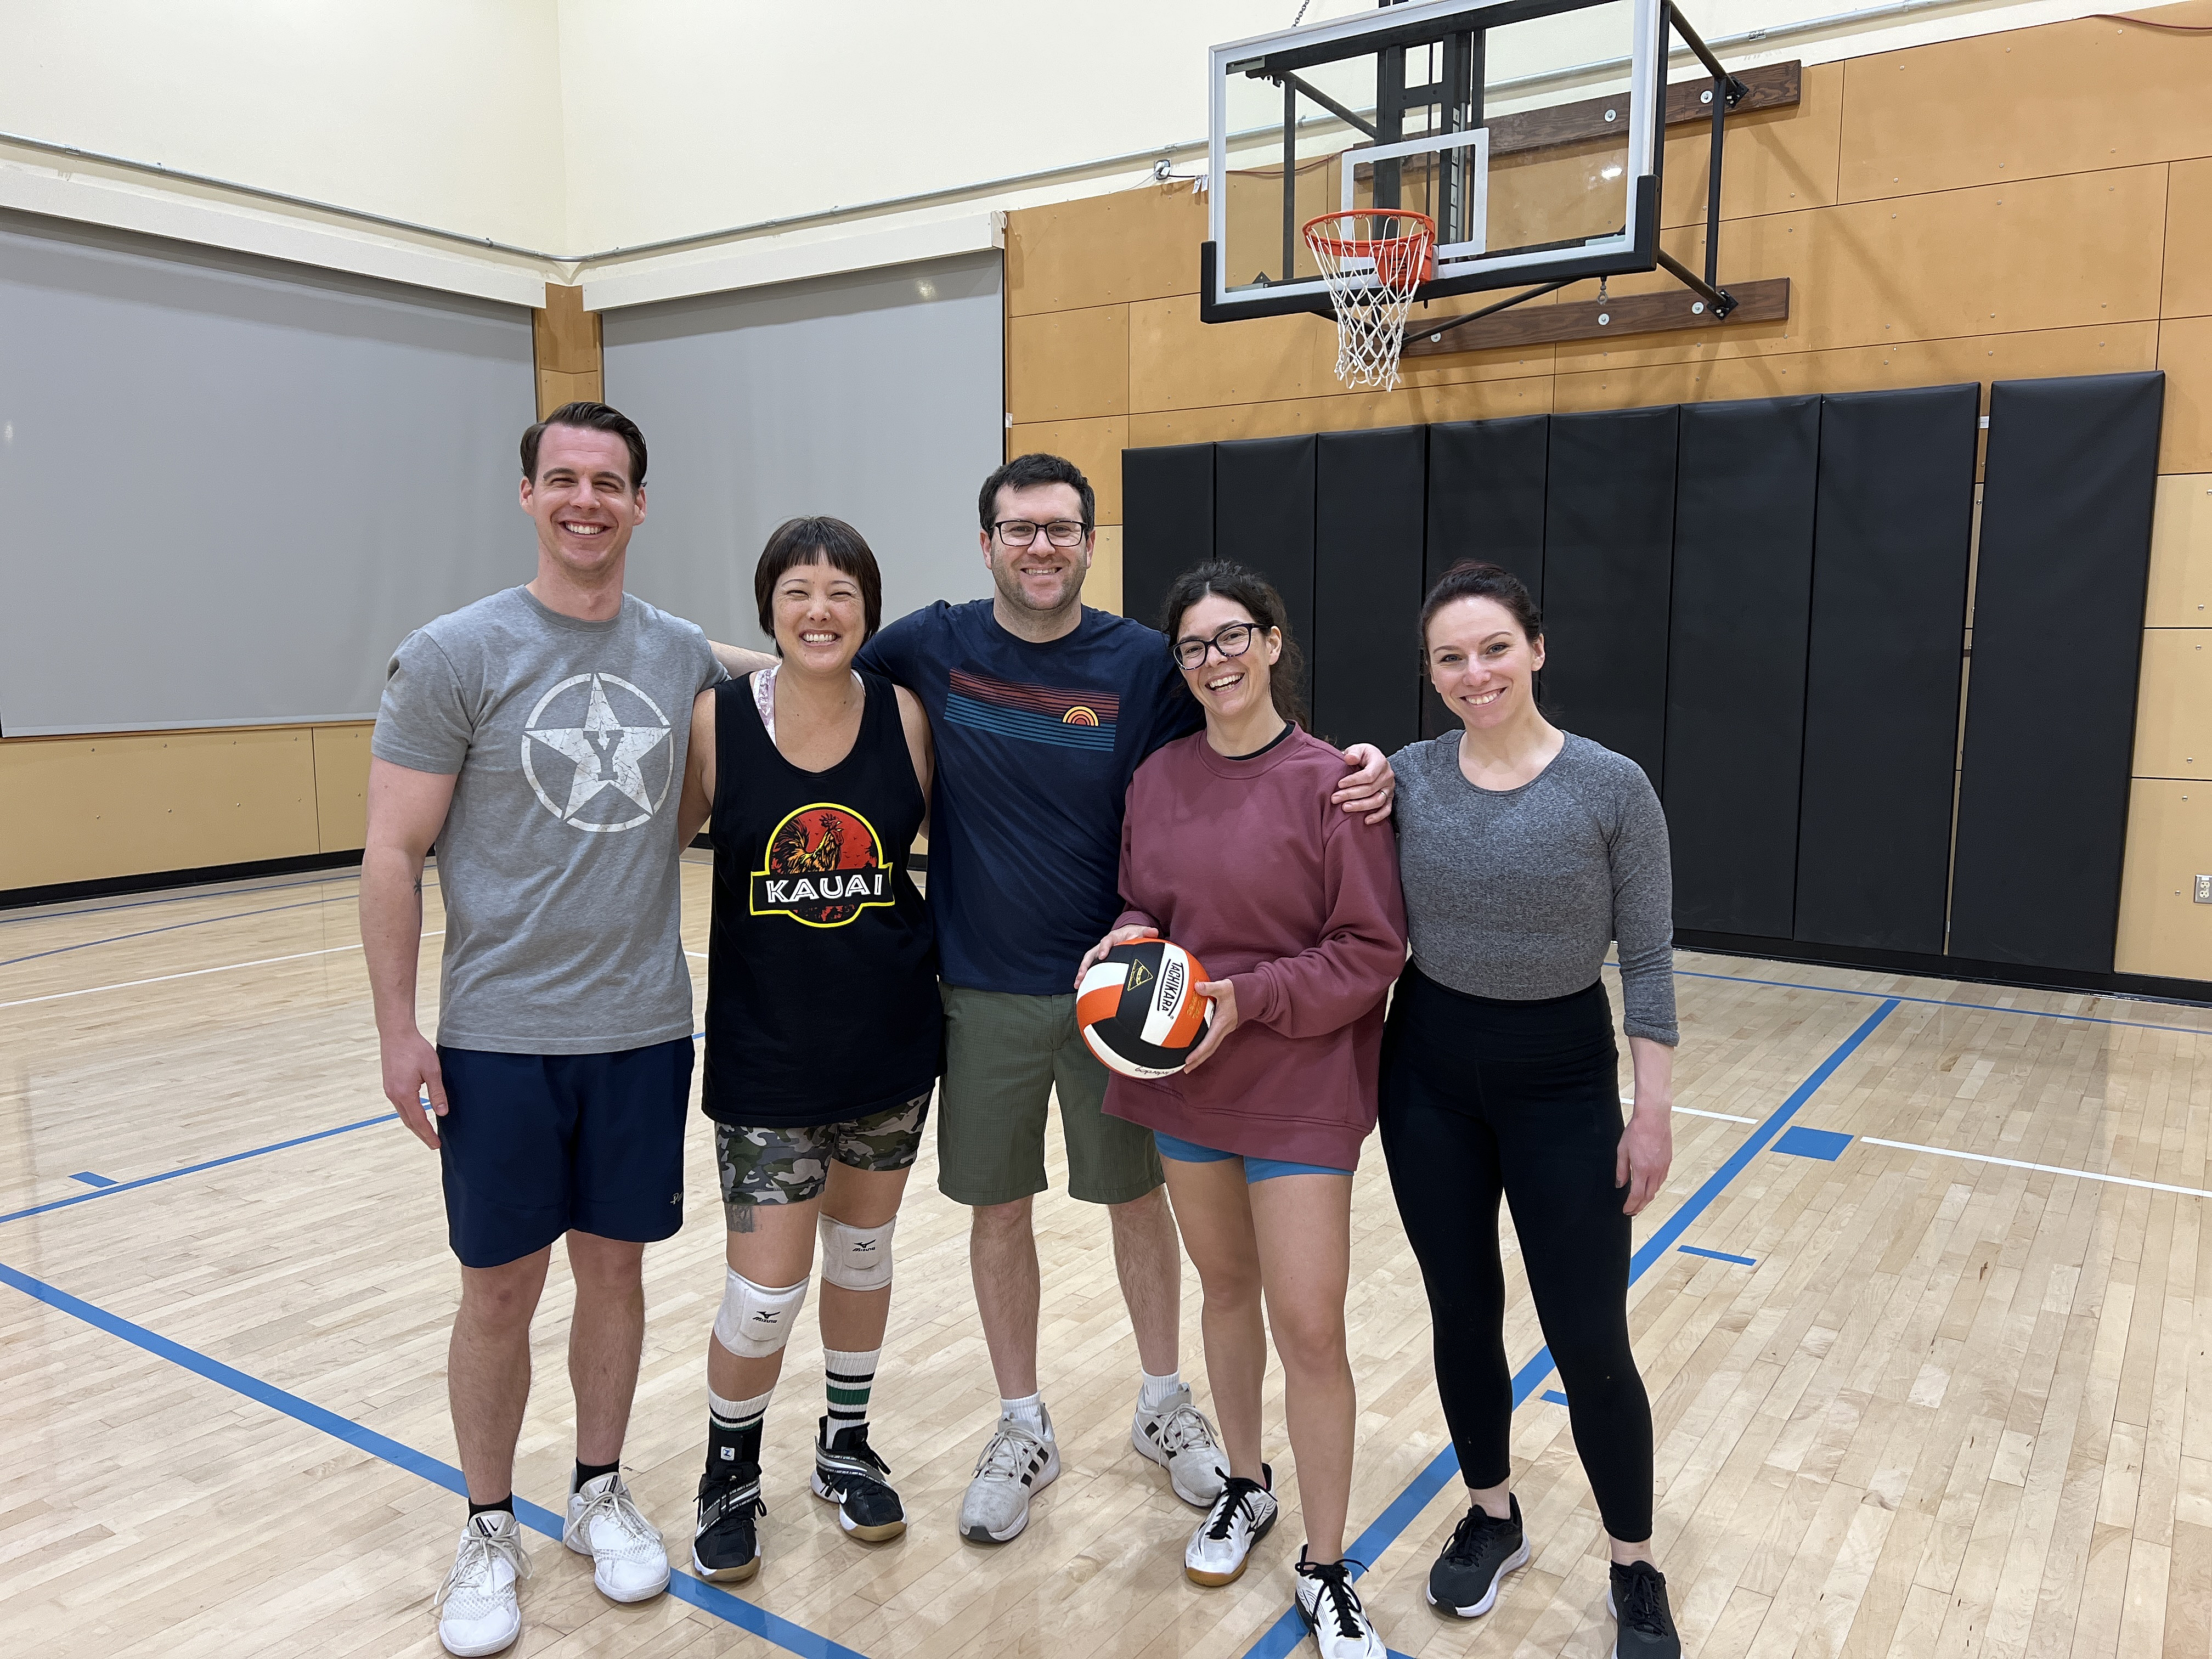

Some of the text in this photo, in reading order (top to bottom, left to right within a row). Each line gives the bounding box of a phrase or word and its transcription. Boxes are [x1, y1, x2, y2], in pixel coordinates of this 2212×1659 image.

[583, 729, 624, 781] Y
[765, 873, 883, 903] KAUAI
[1161, 962, 1184, 1012] TACHIKARA
